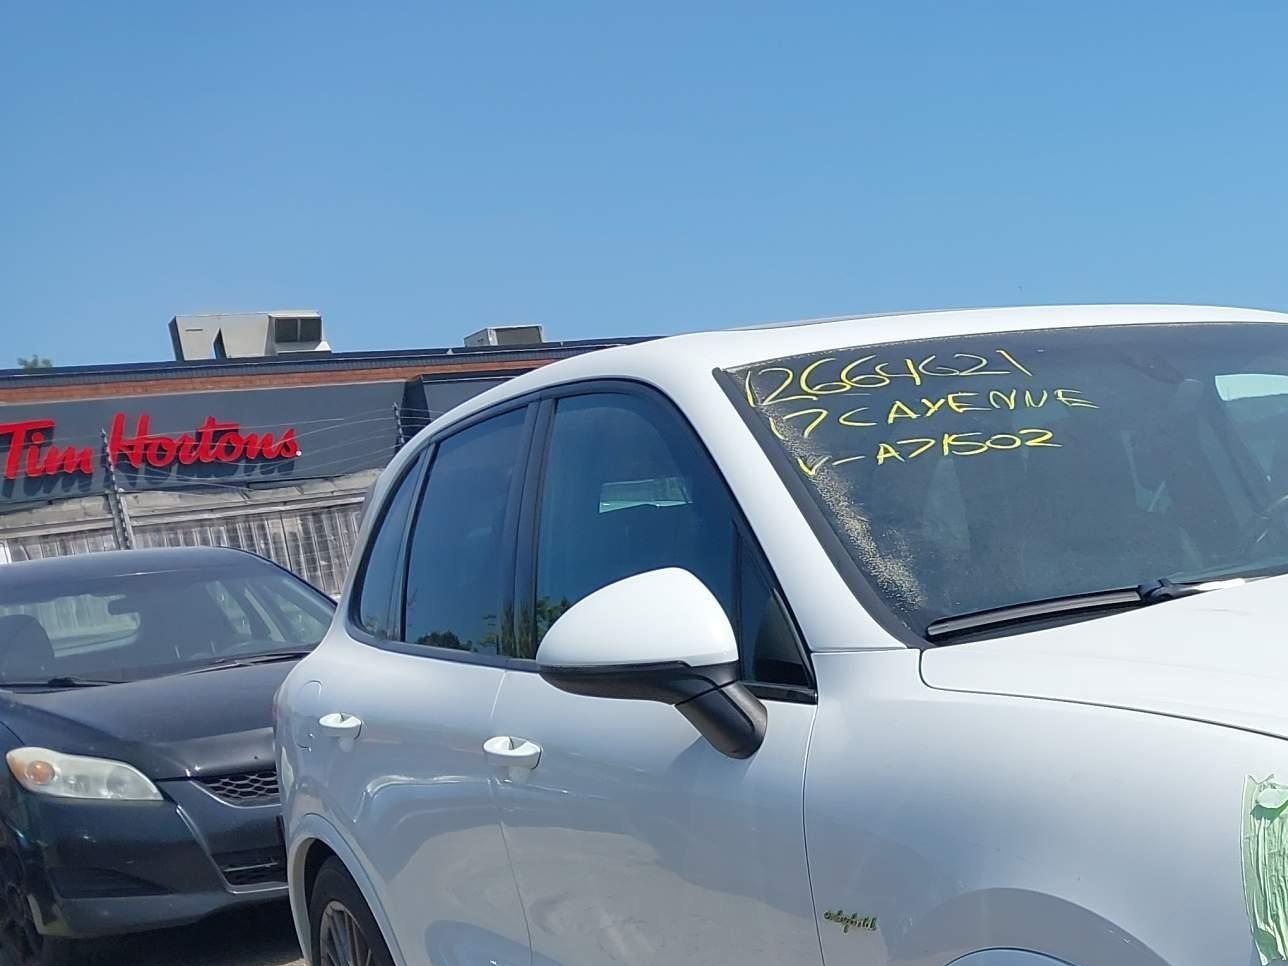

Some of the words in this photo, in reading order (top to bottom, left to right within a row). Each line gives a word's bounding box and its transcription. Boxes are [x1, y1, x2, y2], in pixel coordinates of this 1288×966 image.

[745, 349, 1033, 409] 12664621
[838, 388, 1101, 428] CAYENNE
[0, 419, 94, 480] Tim
[108, 411, 301, 470] Hortons
